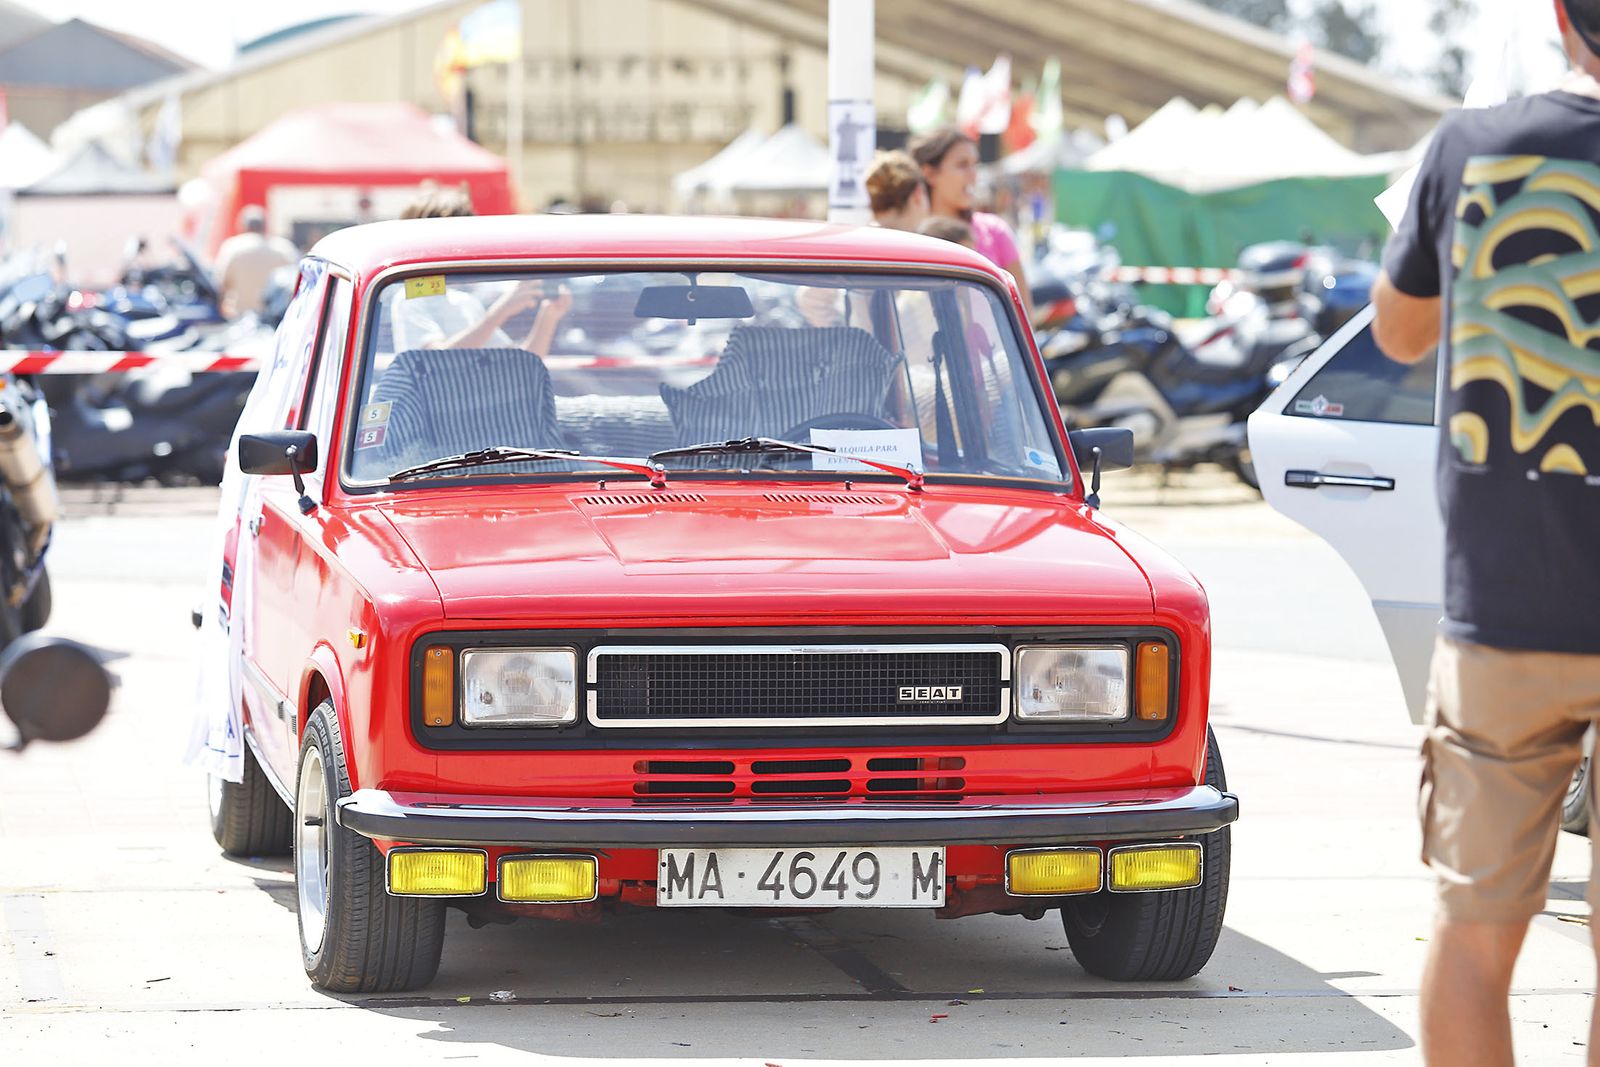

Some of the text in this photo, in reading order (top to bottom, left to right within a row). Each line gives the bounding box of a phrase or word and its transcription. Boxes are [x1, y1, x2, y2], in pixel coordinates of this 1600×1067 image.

[837, 444, 898, 454] ALQUILA PARA
[901, 688, 960, 698] SEAT
[911, 852, 939, 901] M
